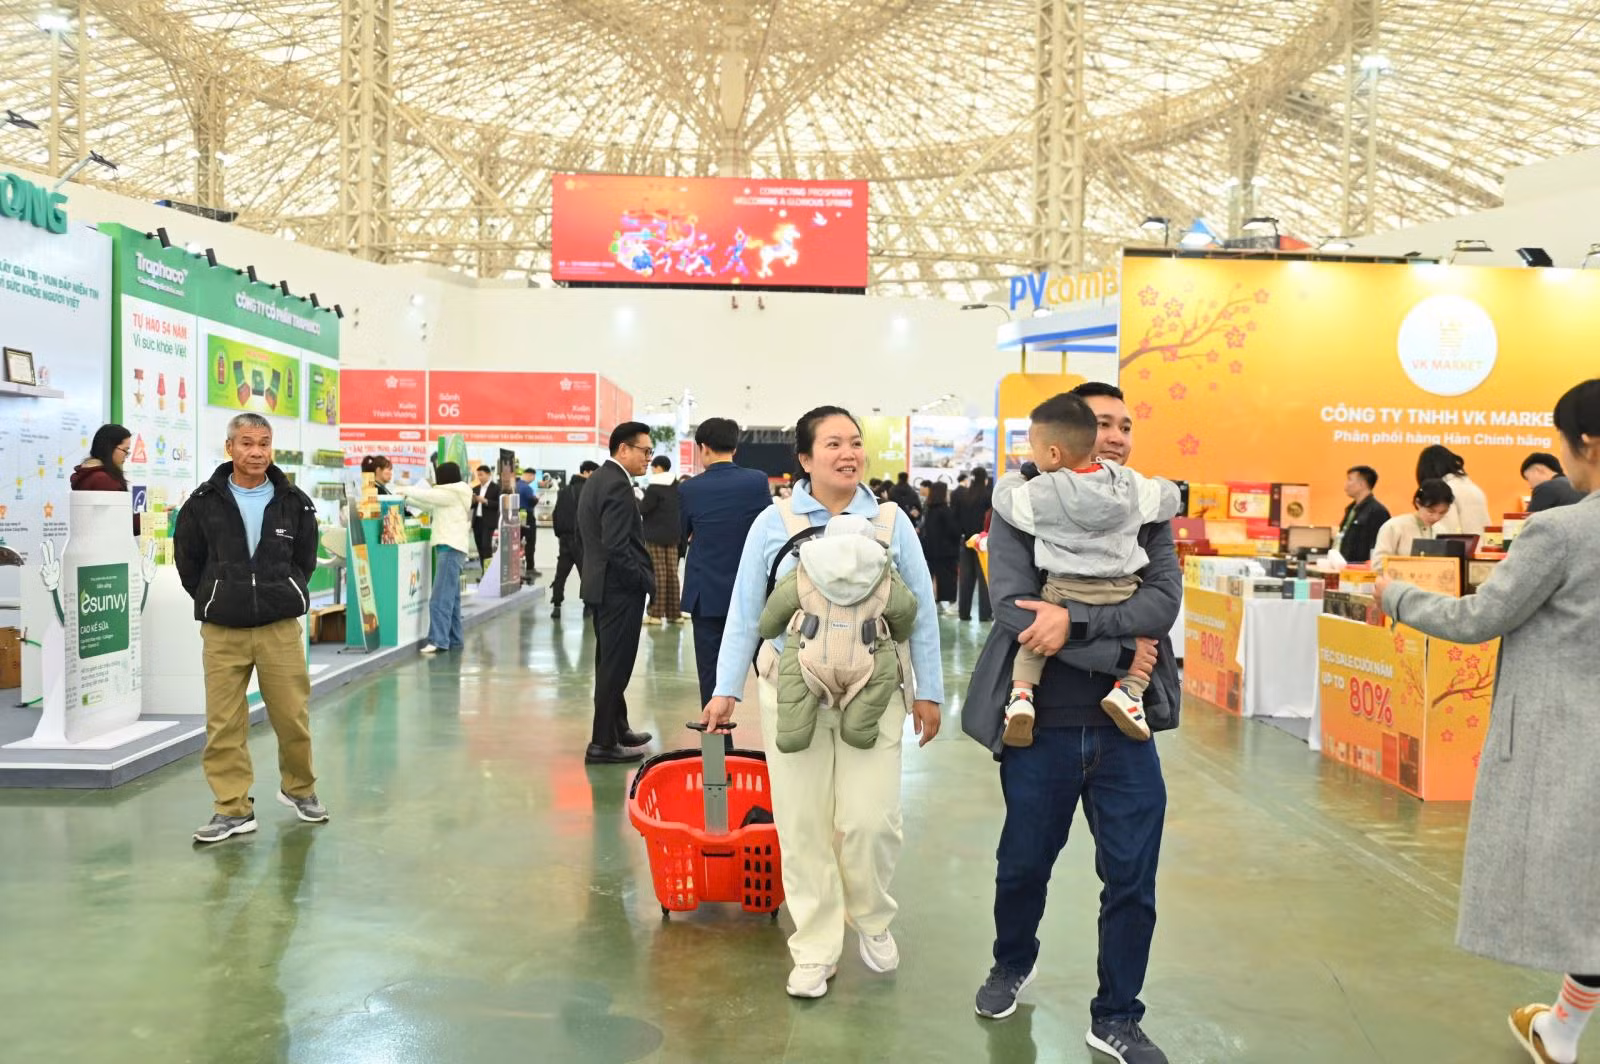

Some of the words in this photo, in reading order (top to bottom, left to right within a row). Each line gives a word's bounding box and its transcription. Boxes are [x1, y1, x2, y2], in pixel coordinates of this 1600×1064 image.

[1412, 359, 1428, 370] VK
[1432, 359, 1484, 371] MARKET
[438, 403, 460, 417] 06
[1321, 402, 1376, 424] CÔNG
[1379, 408, 1403, 424] TY
[1408, 409, 1458, 425] TNHH
[1462, 410, 1487, 426] VK
[1333, 429, 1370, 443] Phân
[1372, 429, 1403, 446] phối
[1405, 431, 1441, 446] hàng
[1443, 431, 1471, 445] Hàn
[1474, 432, 1514, 446] Chính
[1517, 433, 1552, 449] hãng
[1336, 652, 1355, 668] SALE
[1322, 671, 1332, 685] UP
[1333, 675, 1345, 689] TO
[1350, 676, 1392, 727] 80%
